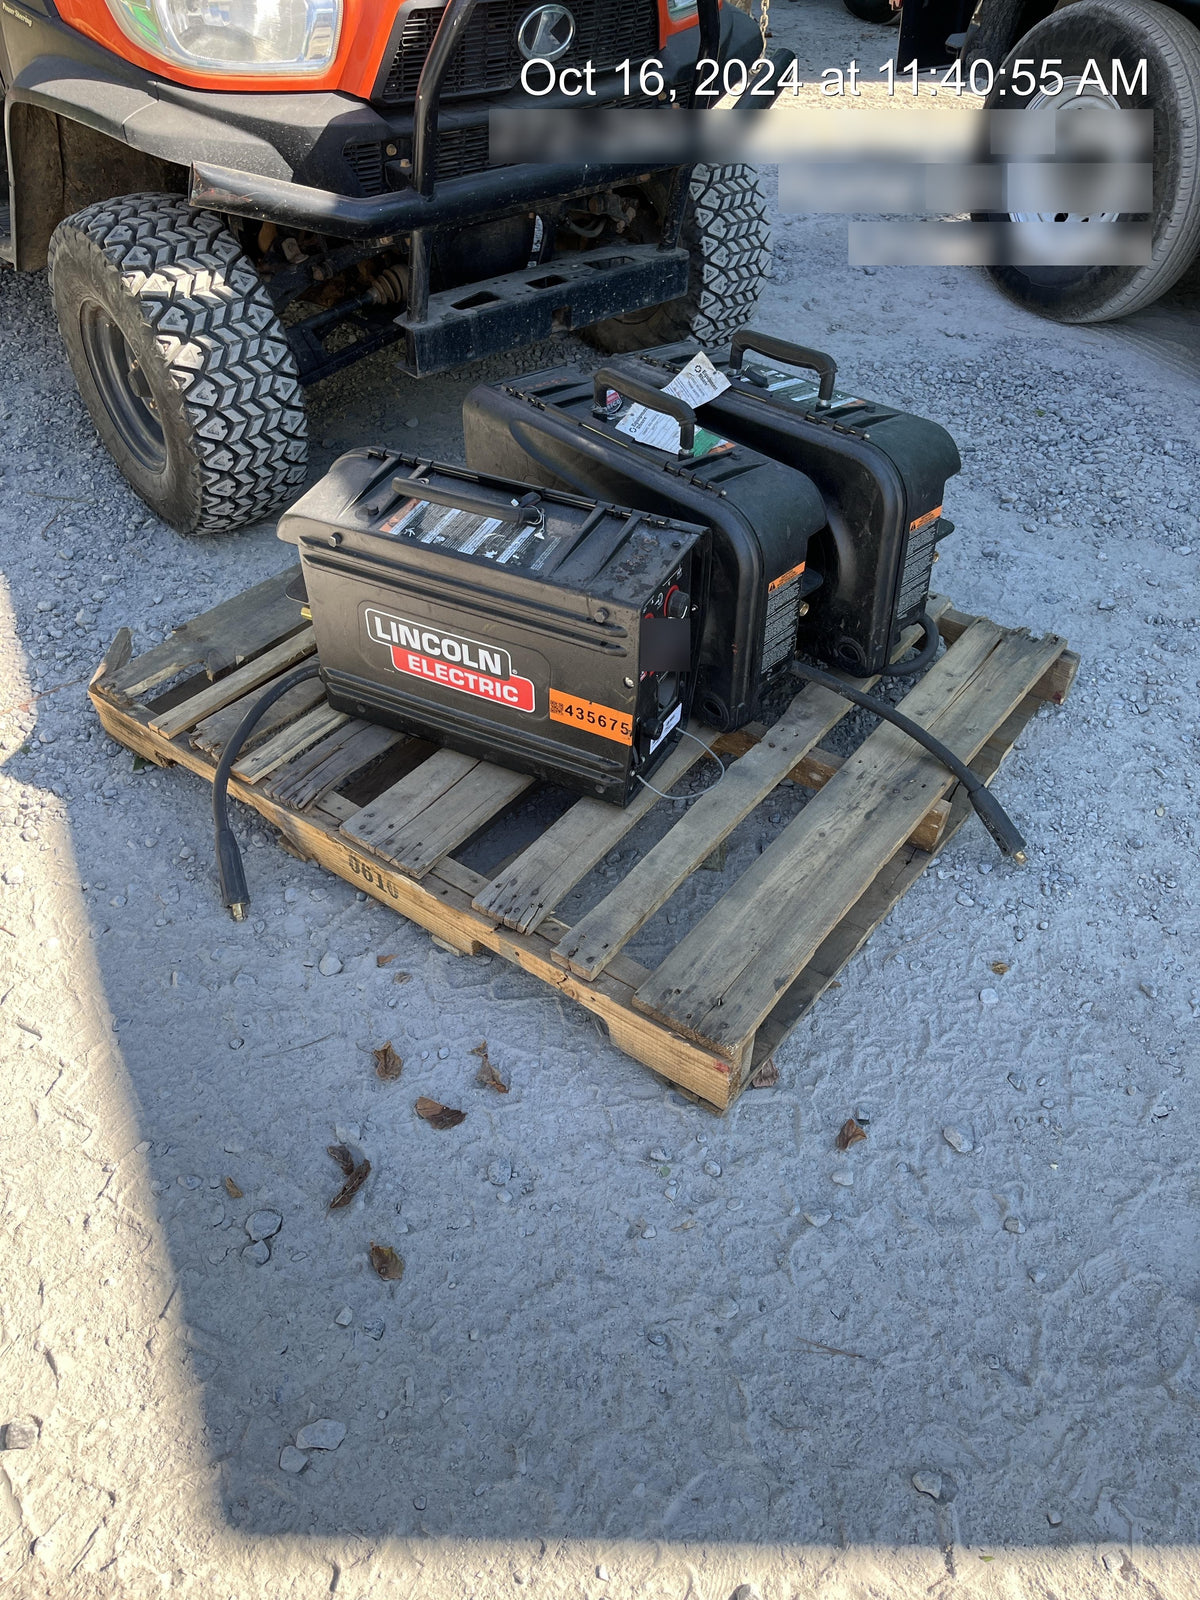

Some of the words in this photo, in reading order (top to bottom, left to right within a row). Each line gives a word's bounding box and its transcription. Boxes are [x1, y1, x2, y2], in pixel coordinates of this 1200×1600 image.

[374, 616, 502, 675] LINCOLN
[407, 653, 519, 703] ELECTRIC
[564, 704, 629, 736] 435675
